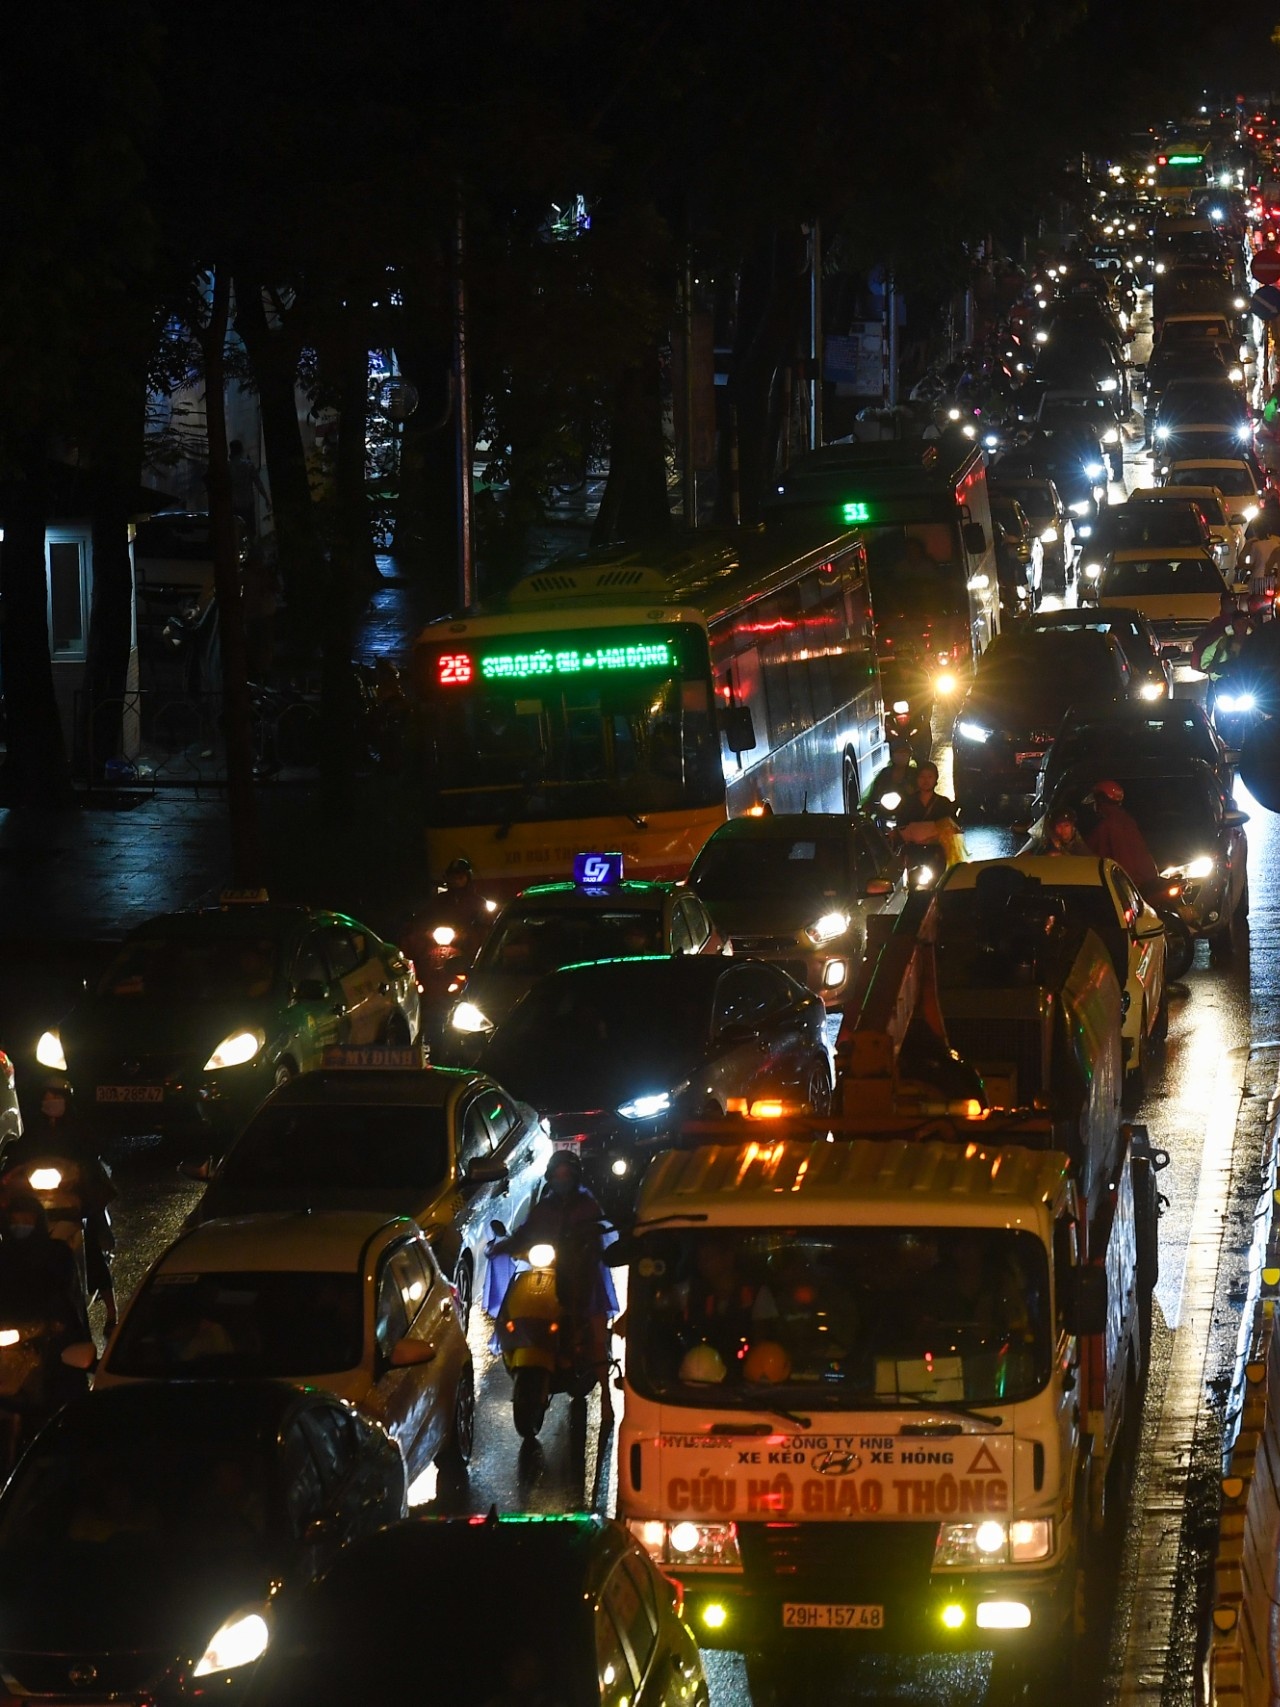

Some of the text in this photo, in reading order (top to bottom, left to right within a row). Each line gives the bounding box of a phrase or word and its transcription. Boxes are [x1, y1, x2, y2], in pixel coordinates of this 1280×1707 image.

[439, 654, 471, 683] 26
[584, 857, 610, 882] G7
[781, 1434, 827, 1449] CÔNG
[834, 1438, 854, 1449] TY
[860, 1437, 893, 1449] HNB
[738, 1452, 761, 1464] XE
[870, 1452, 894, 1464] XE
[667, 1468, 1008, 1518] CỨU HỘ GIAO THÔNG
[786, 1607, 880, 1626] 29H-157.48
